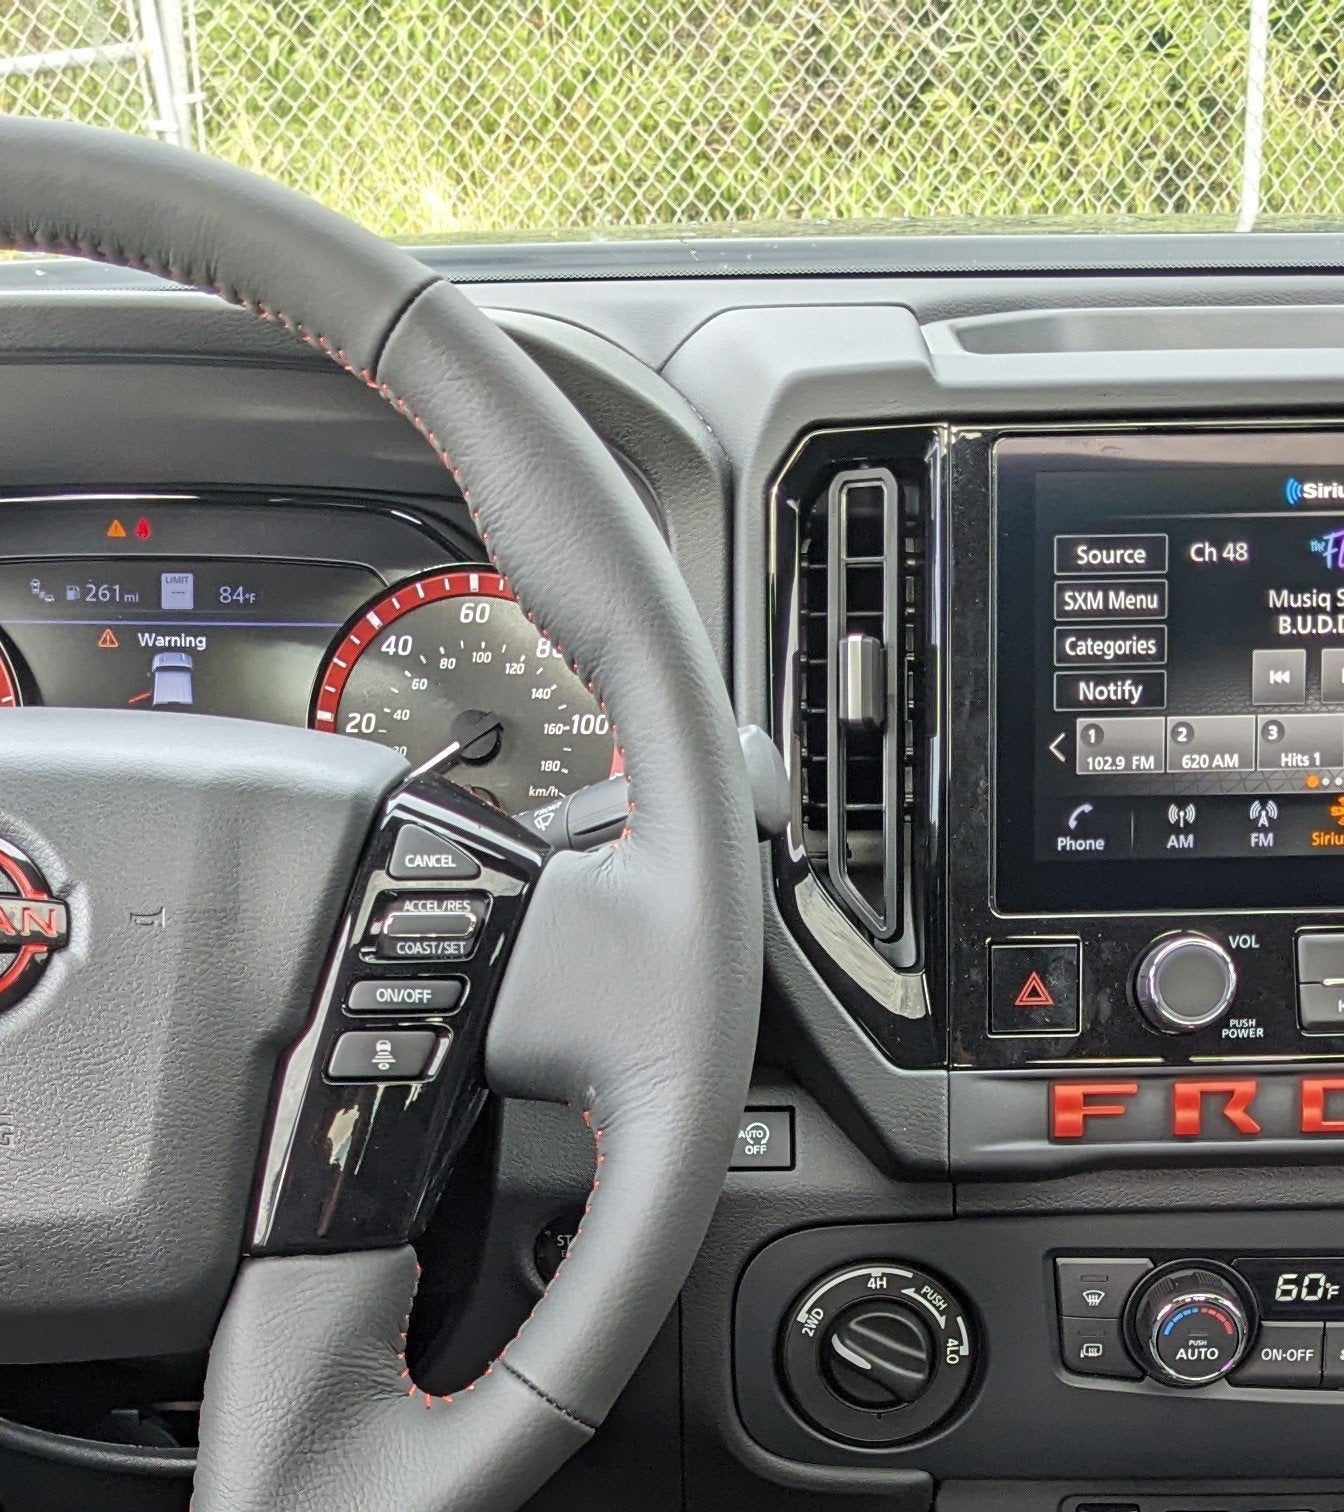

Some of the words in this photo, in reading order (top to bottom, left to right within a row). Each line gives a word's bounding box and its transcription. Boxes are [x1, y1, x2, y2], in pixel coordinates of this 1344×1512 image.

[1076, 544, 1147, 564] Source
[1189, 543, 1218, 563] Ch
[1222, 542, 1249, 562] 48
[165, 575, 190, 584] LIMIT
[85, 584, 121, 603] 261
[1064, 590, 1104, 610] SXM
[1108, 589, 1158, 610] Menu
[1268, 588, 1332, 611] Musiq
[459, 603, 490, 624] 60
[137, 632, 207, 651] Warning
[381, 634, 413, 656] 40
[1064, 636, 1156, 659] Categories
[439, 657, 457, 670] 80
[471, 651, 492, 664] 100
[505, 663, 525, 675] 120
[411, 678, 428, 690] 60
[531, 688, 551, 699] 140
[1078, 680, 1143, 705] Notify
[393, 709, 410, 721] 40
[345, 712, 376, 734] 20
[543, 723, 563, 735] 160
[571, 714, 609, 735] 100
[1088, 729, 1096, 744] 1
[1177, 727, 1188, 742] 2
[1267, 726, 1278, 741] 3
[540, 760, 561, 772] 180
[1086, 756, 1126, 772] 102.9
[1132, 755, 1155, 771] FM
[1181, 754, 1209, 769] 620
[1211, 753, 1239, 768] AM
[1280, 752, 1309, 768] Hits
[1312, 752, 1321, 768] 1
[528, 785, 559, 797] km/h
[1057, 836, 1105, 852] Phone
[1166, 834, 1194, 849] AM
[1250, 833, 1274, 848] FM
[405, 854, 456, 868] CANCEL
[403, 899, 471, 912] ACCEL/RES
[396, 942, 467, 955] COAST/SET
[1228, 935, 1259, 950] VOL
[376, 988, 432, 1004] ON/OFF
[1229, 1018, 1256, 1029] PUSH
[1222, 1028, 1264, 1039] POWER
[737, 1130, 764, 1139] AUTO
[744, 1145, 767, 1155] OFF
[867, 1277, 887, 1290] 4H
[920, 1284, 949, 1313] PUSH
[801, 1307, 825, 1338] 2WD
[945, 1337, 959, 1365] 4LO
[1176, 1347, 1219, 1361] AUTO
